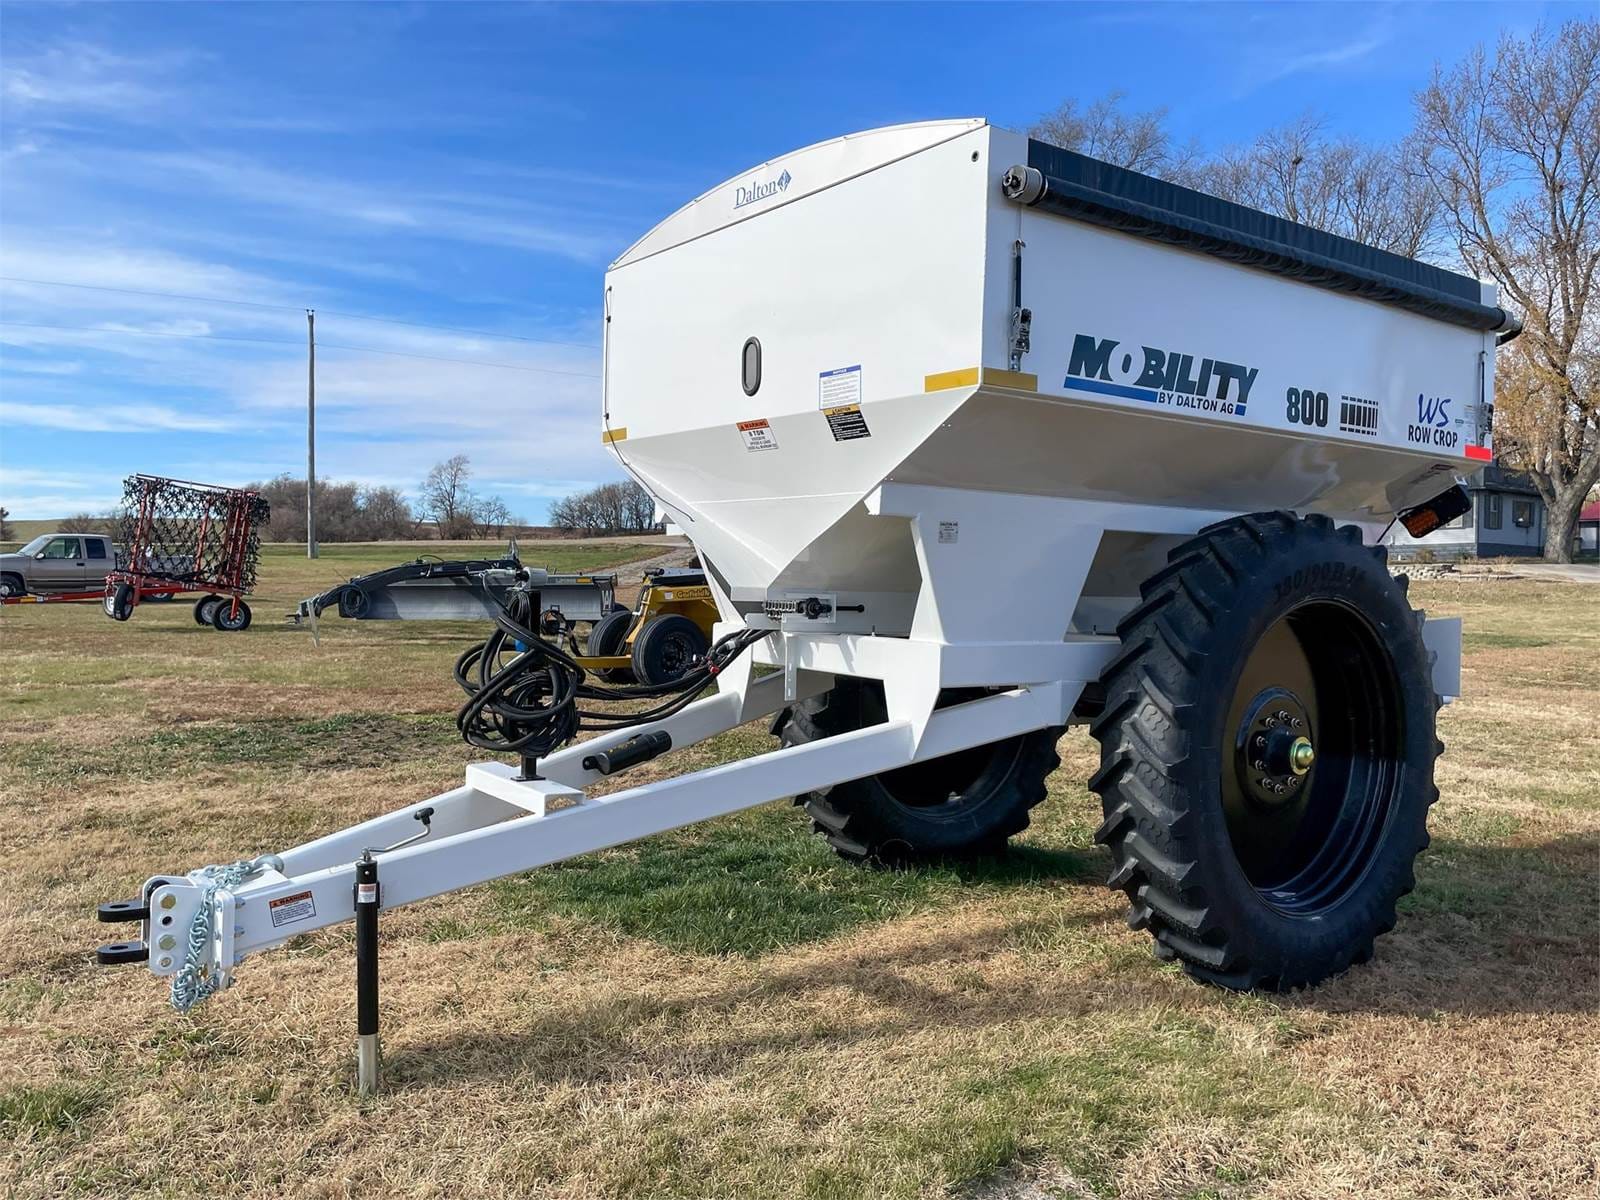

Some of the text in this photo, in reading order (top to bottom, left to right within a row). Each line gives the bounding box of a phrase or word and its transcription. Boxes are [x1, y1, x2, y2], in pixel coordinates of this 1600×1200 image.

[735, 181, 777, 206] Dalton
[1067, 333, 1259, 405] MOBILITY
[1158, 391, 1235, 415] BY DALTON AG
[1286, 387, 1329, 428] 800
[1418, 393, 1452, 428] WS
[1408, 424, 1459, 448] ROW CROP
